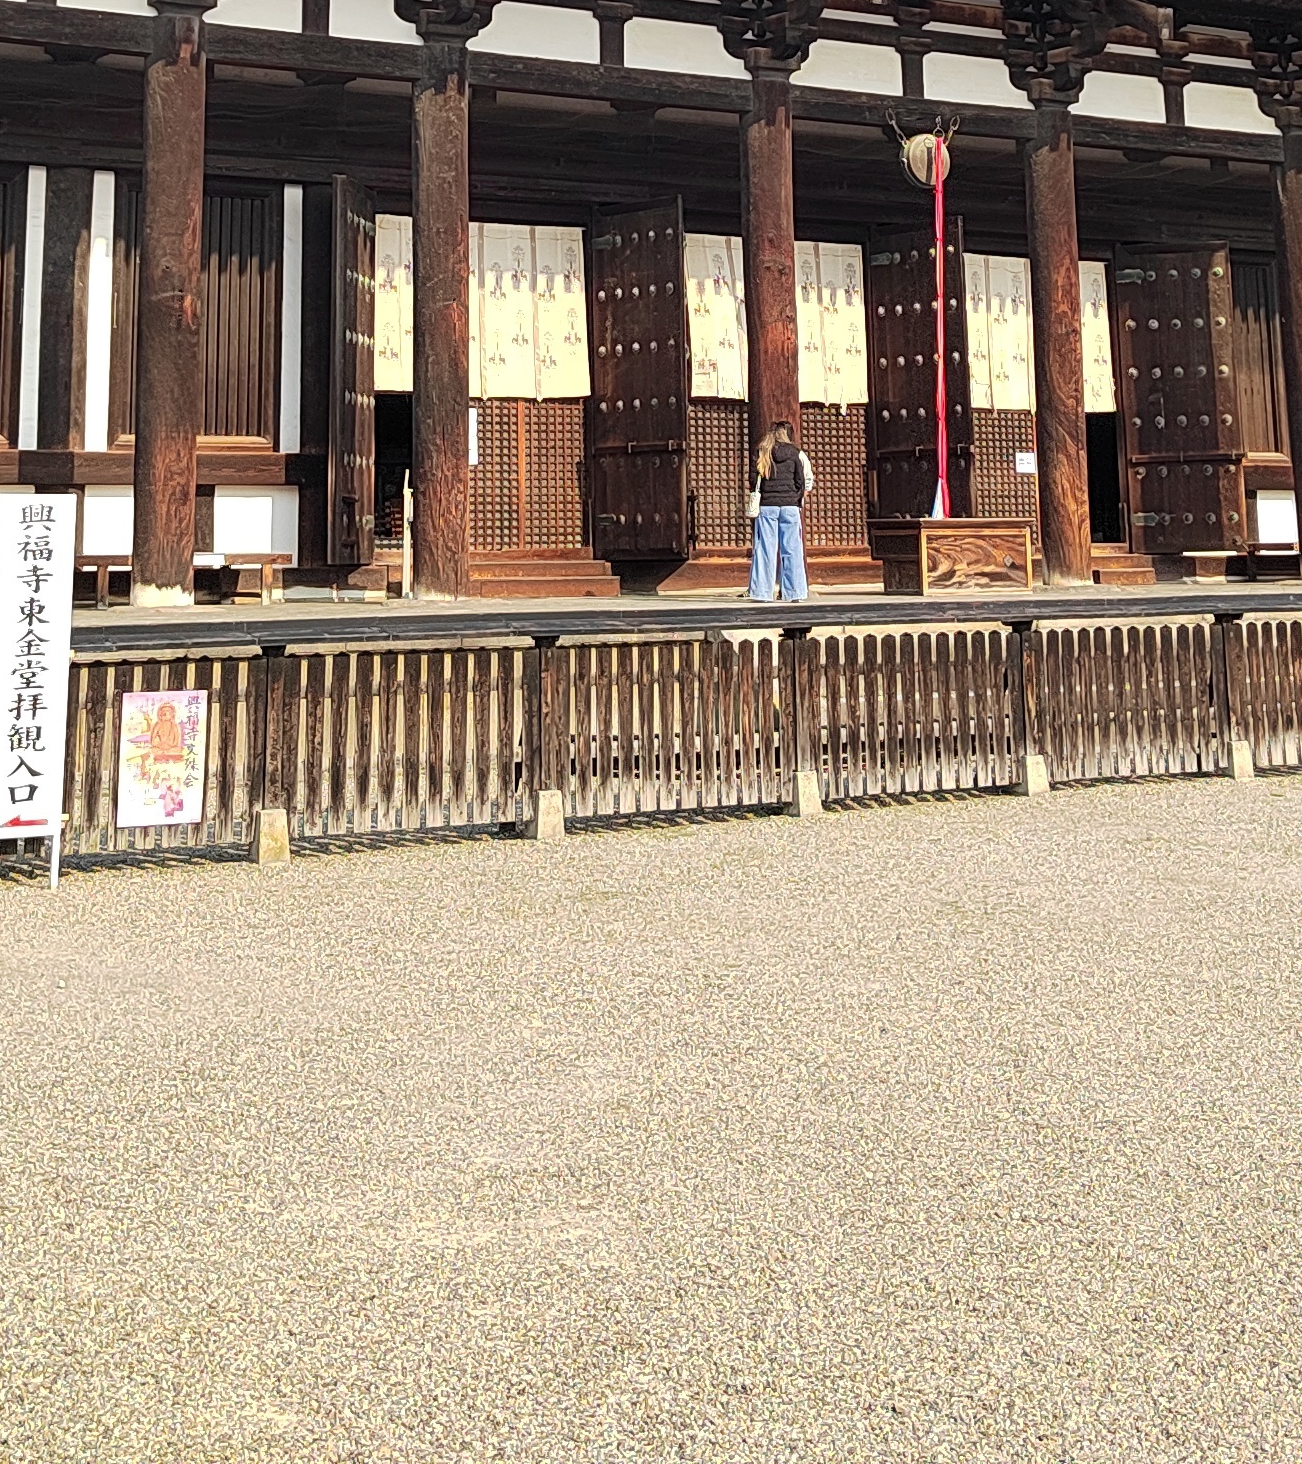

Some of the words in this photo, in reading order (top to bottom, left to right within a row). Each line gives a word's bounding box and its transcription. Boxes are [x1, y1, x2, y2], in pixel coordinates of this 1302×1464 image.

[6, 503, 56, 805] 興福寺東金堂拝観入口
